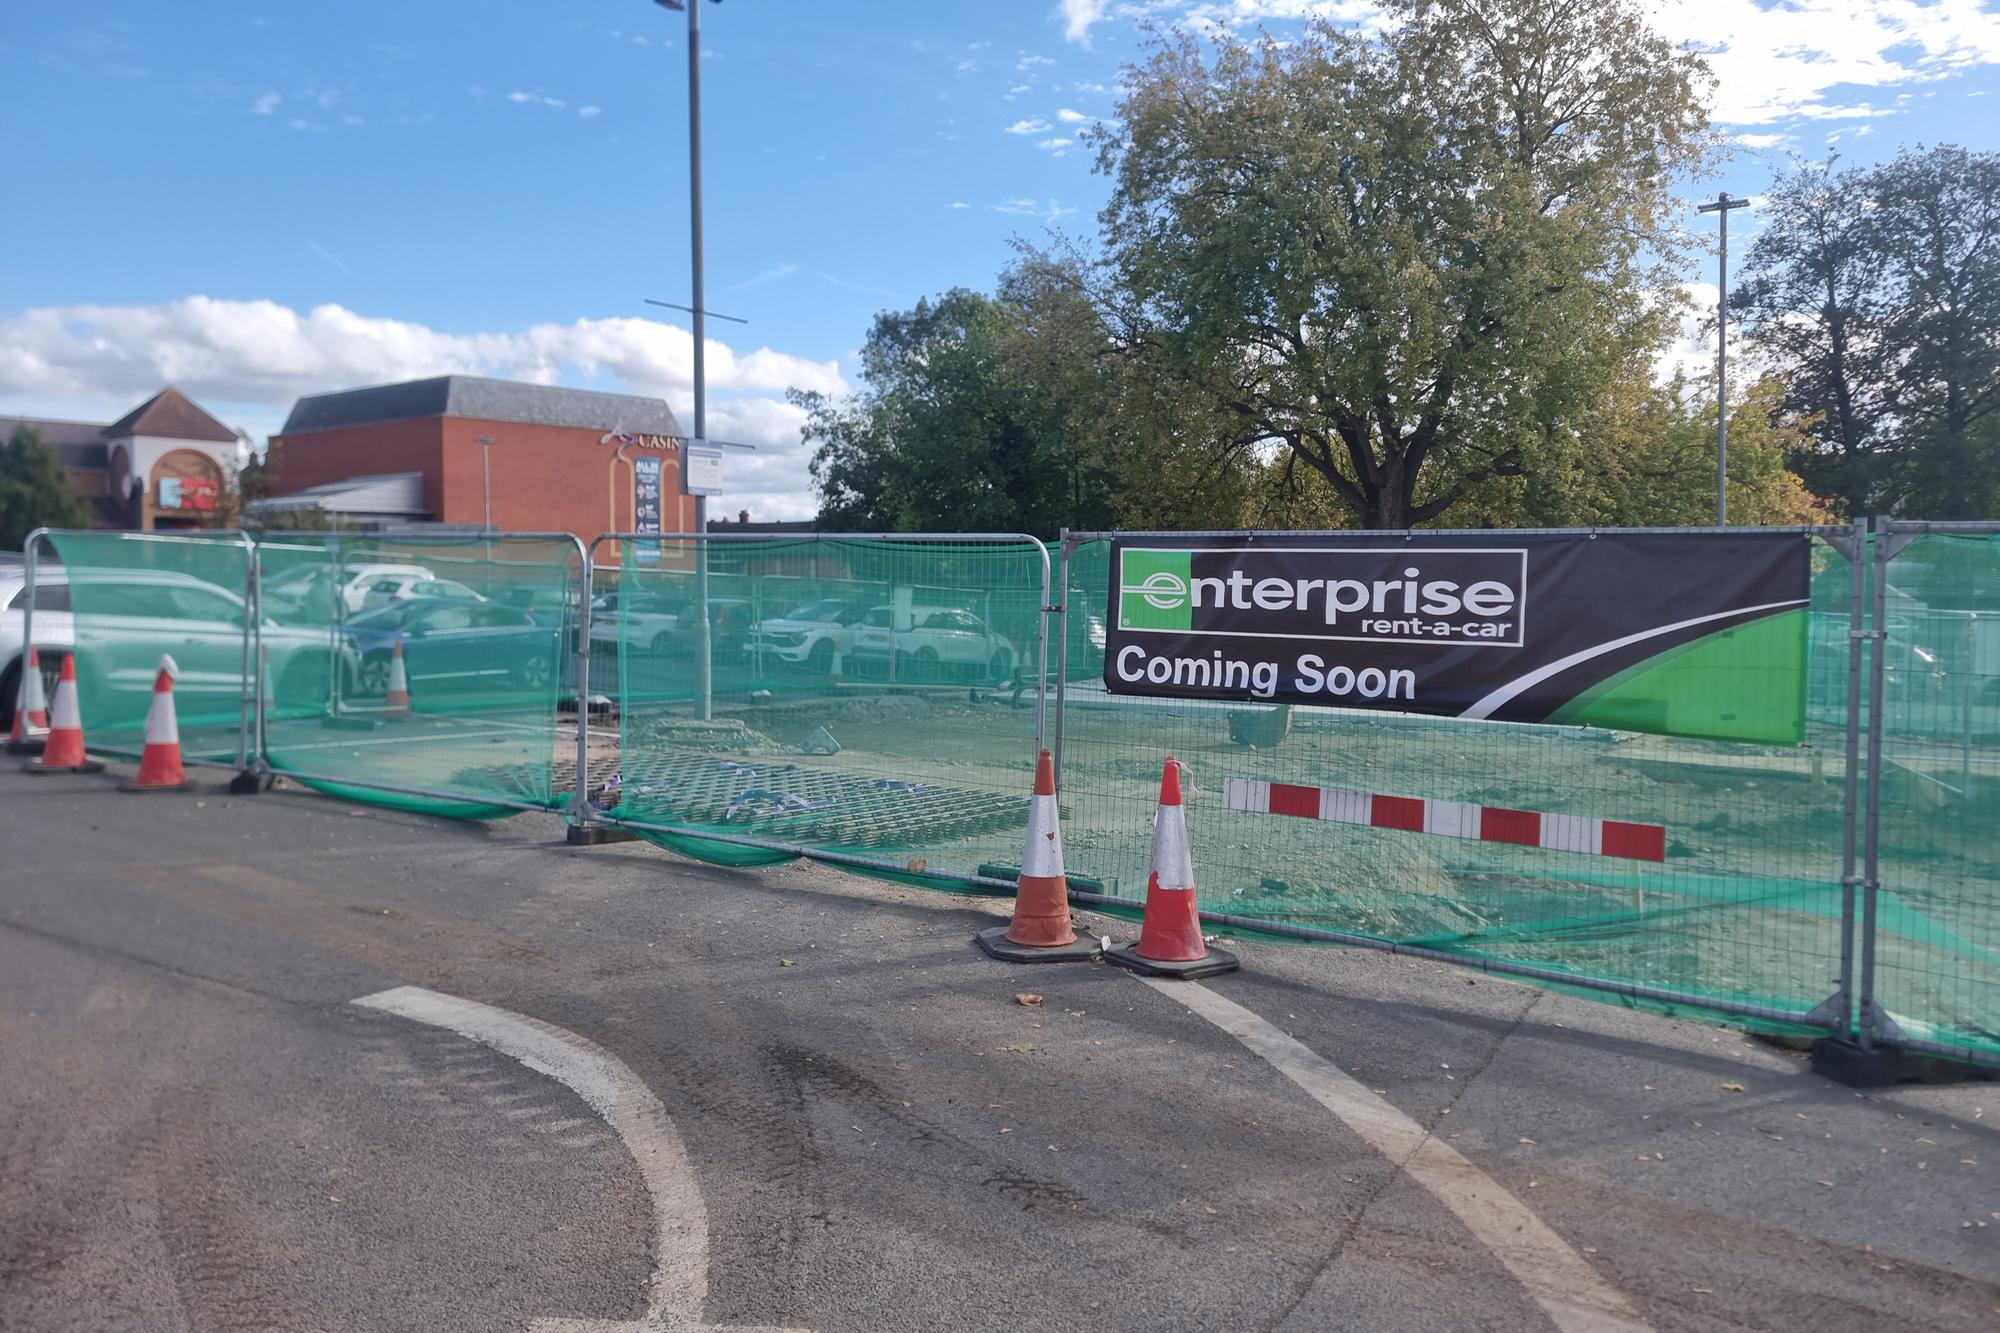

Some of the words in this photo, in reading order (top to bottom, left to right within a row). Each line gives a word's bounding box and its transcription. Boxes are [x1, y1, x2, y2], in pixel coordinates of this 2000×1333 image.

[638, 434, 679, 450] CASIN
[1123, 567, 1515, 625] enterprise
[1361, 616, 1513, 638] rent-a-car
[1116, 645, 1279, 698] Coming
[1294, 653, 1416, 700] Soon
